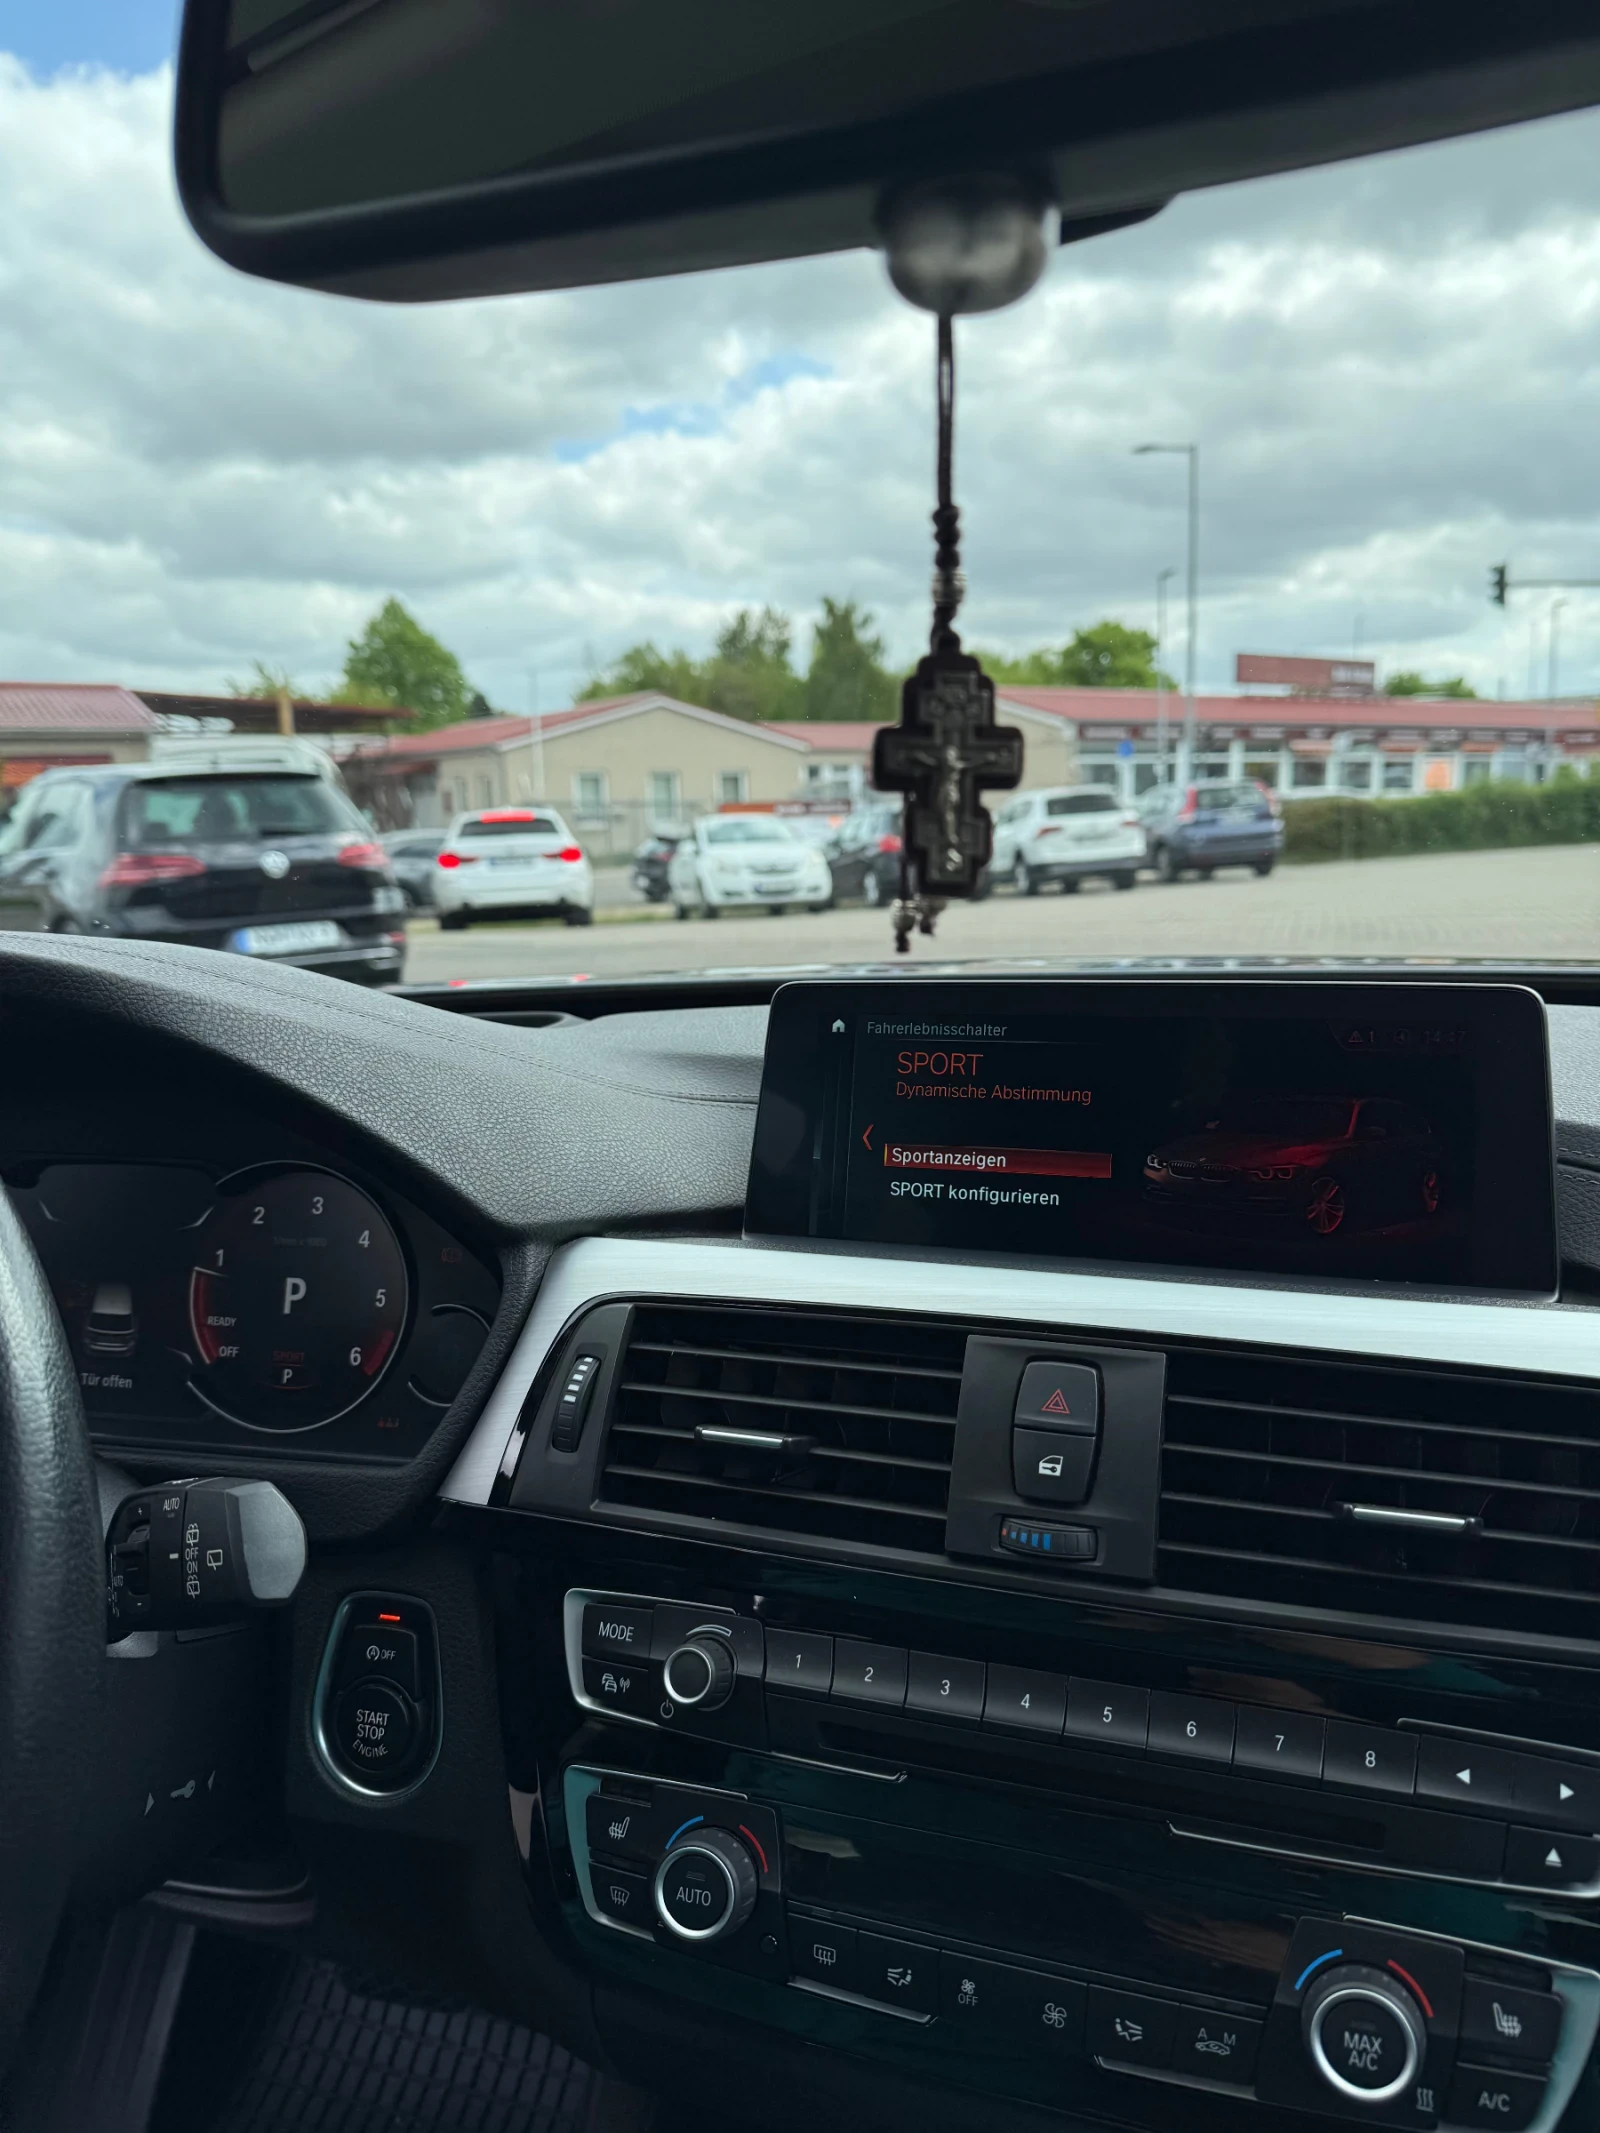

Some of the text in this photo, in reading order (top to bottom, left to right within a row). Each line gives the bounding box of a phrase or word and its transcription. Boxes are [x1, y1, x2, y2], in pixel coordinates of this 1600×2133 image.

[867, 1021, 1008, 1037] Fahrerlebnisschalter
[897, 1051, 984, 1076] SPORT
[896, 1081, 1093, 1106] Dynamische Abstimmung
[892, 1147, 1007, 1169] Sportanzeigen
[890, 1181, 1060, 1206] SPORT konfigurieren
[311, 1196, 325, 1215] 3
[252, 1206, 265, 1225] 2
[358, 1229, 370, 1248] 4
[215, 1248, 225, 1267] 1
[282, 1276, 308, 1315] P
[375, 1288, 387, 1308] 5
[207, 1315, 238, 1328] READY
[218, 1345, 240, 1358] OFF
[350, 1346, 363, 1367] 6
[80, 1373, 133, 1389] Tür offen
[281, 1368, 293, 1385] P
[163, 1497, 180, 1511] AUTO
[185, 1548, 199, 1560] OFF
[187, 1562, 198, 1573] ON
[597, 1620, 636, 1643] MODE
[381, 1649, 396, 1660] OFF
[794, 1653, 803, 1670] 1
[864, 1666, 874, 1684] 2
[940, 1679, 951, 1696] 3
[1020, 1692, 1031, 1710] 4
[356, 1709, 390, 1726] START
[1102, 1706, 1113, 1724] 5
[357, 1723, 385, 1740] STOP
[1186, 1720, 1197, 1738] 6
[352, 1739, 388, 1758] ENGINE
[1274, 1734, 1285, 1752] 7
[1364, 1750, 1377, 1769] 8
[675, 1886, 712, 1908] AUTO
[957, 1991, 979, 2007] OFF
[1343, 2030, 1383, 2055] MAX
[1347, 2049, 1379, 2071] A/C
[1478, 2088, 1511, 2113] A/C
